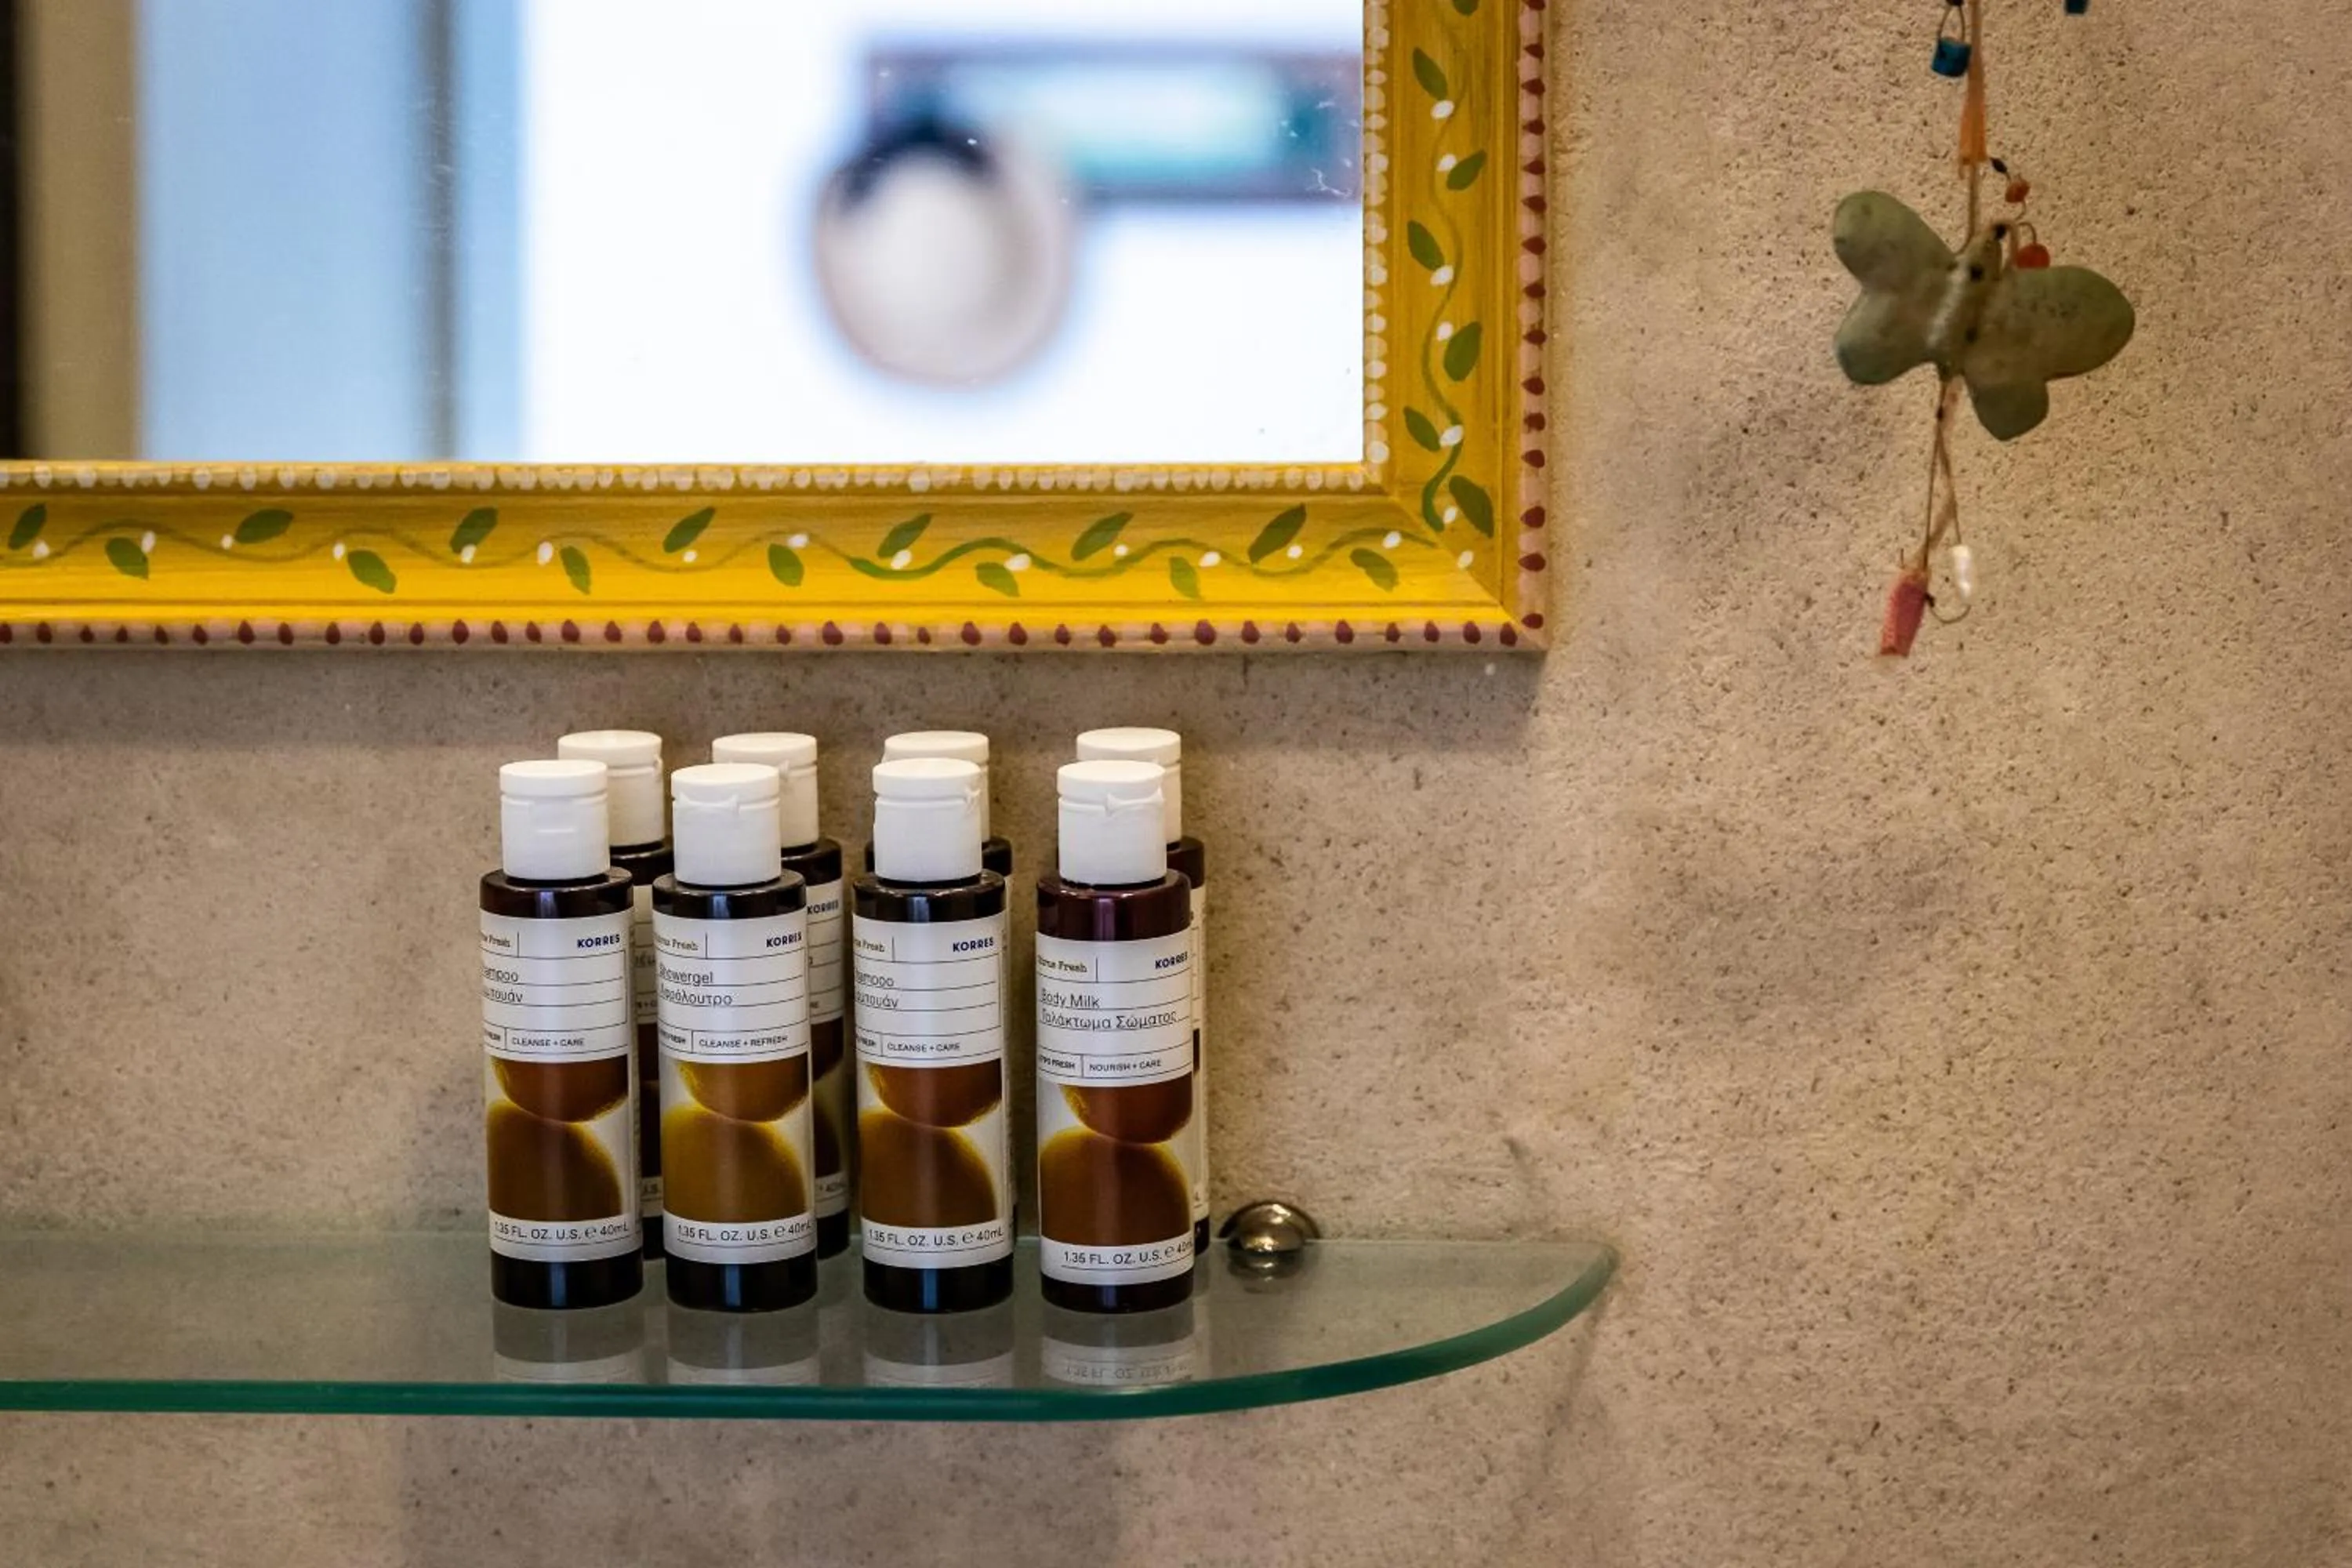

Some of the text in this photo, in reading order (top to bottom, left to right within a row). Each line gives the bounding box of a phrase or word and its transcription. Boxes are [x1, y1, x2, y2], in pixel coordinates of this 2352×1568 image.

[577, 934, 620, 948] KORRES
[766, 931, 802, 948] KORRES
[953, 936, 993, 953] KORRES
[1155, 951, 1188, 969] KORRES
[1040, 988, 1100, 1008] Body Milk
[512, 1037, 550, 1047] CLEANSE
[699, 1039, 741, 1048] CLEANSE
[750, 1035, 788, 1047] REFRESH
[887, 1042, 927, 1052] CLEANSE
[1089, 1062, 1130, 1072] NOURISH
[556, 1229, 581, 1240] U.S.
[747, 1229, 771, 1241] U.S.
[934, 1234, 959, 1246] U.S.
[1139, 1250, 1162, 1262] U.S.
